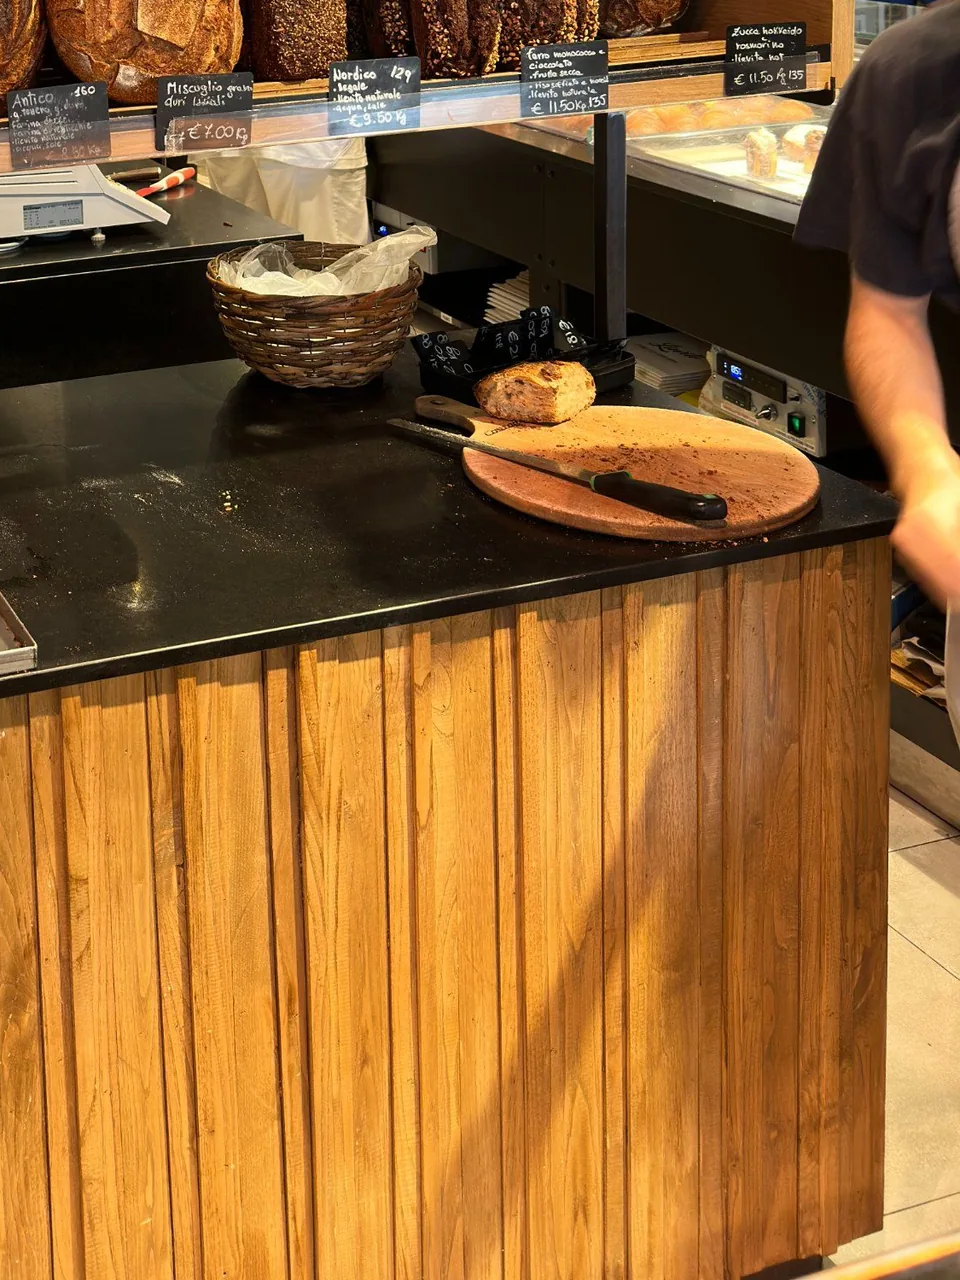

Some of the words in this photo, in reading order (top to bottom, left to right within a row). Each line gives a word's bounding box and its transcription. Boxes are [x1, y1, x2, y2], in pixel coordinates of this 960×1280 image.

[732, 27, 760, 37] Zucca
[736, 40, 784, 50] rosmarino
[735, 51, 763, 62] lievito
[333, 66, 377, 81] Nordico
[391, 65, 412, 83] 129
[532, 70, 557, 79] frutta
[734, 74, 745, 85] €
[749, 70, 773, 83] 11.50
[789, 70, 804, 79] 135
[12, 91, 54, 109] Antico
[74, 86, 96, 97] 160
[365, 88, 401, 102] naturale
[531, 89, 558, 98] lievito
[562, 87, 597, 97] naturale
[165, 95, 187, 107] duri
[531, 103, 544, 114] €
[549, 99, 575, 113] 11.50
[589, 94, 606, 108] 135
[349, 114, 363, 127] €
[364, 111, 392, 125] 9.50
[187, 122, 201, 139] €
[204, 123, 234, 139] 7.00
